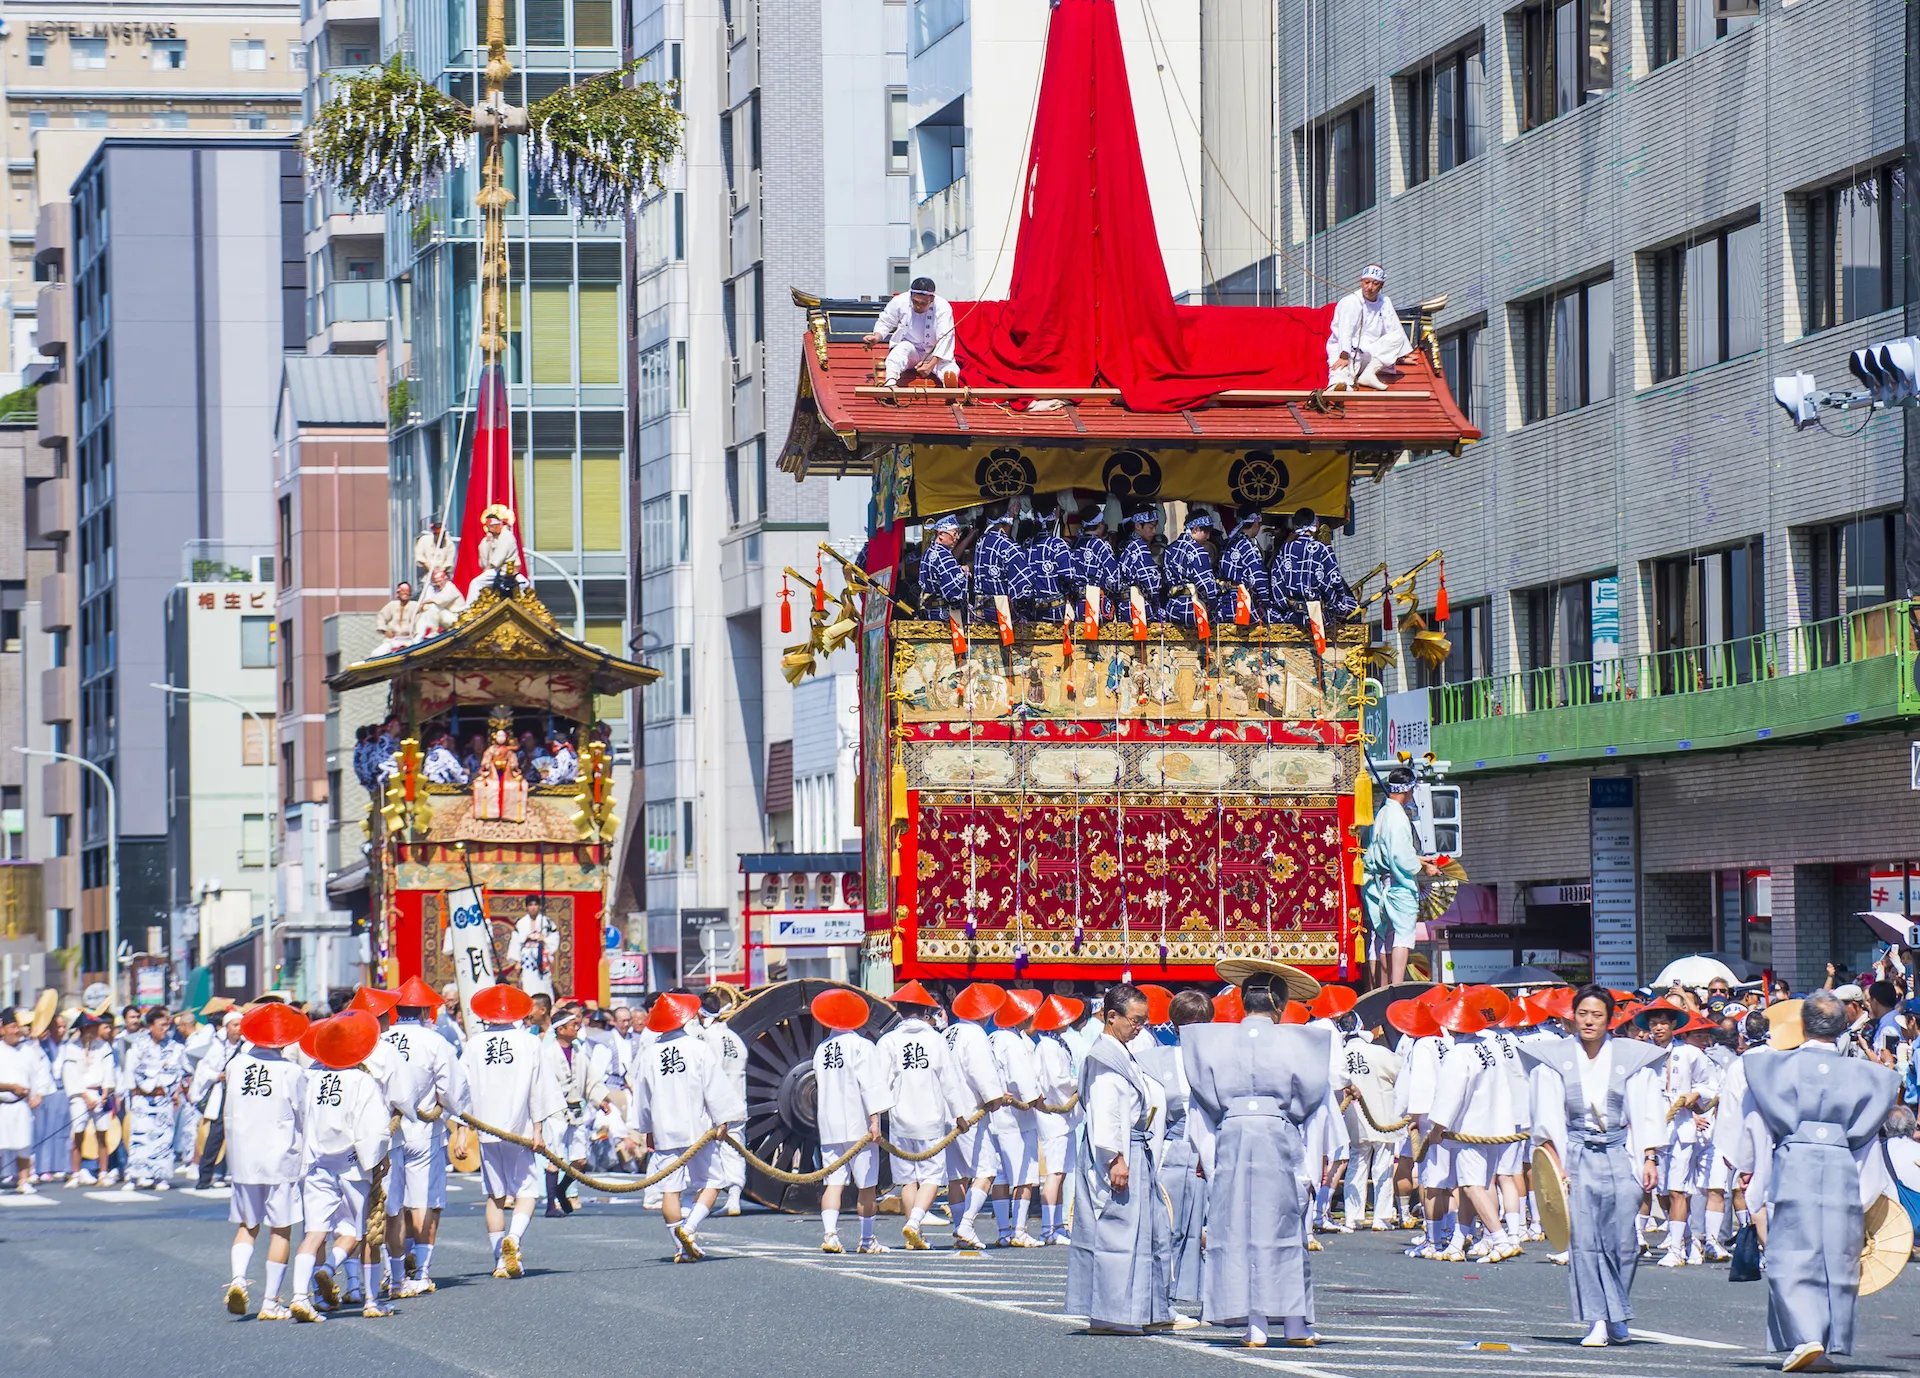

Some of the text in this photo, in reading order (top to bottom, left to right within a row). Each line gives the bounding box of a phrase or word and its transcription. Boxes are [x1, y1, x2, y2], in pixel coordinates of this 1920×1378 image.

[28, 21, 177, 39] HOTEL MYSTAYS
[198, 592, 277, 609] 相生ビ
